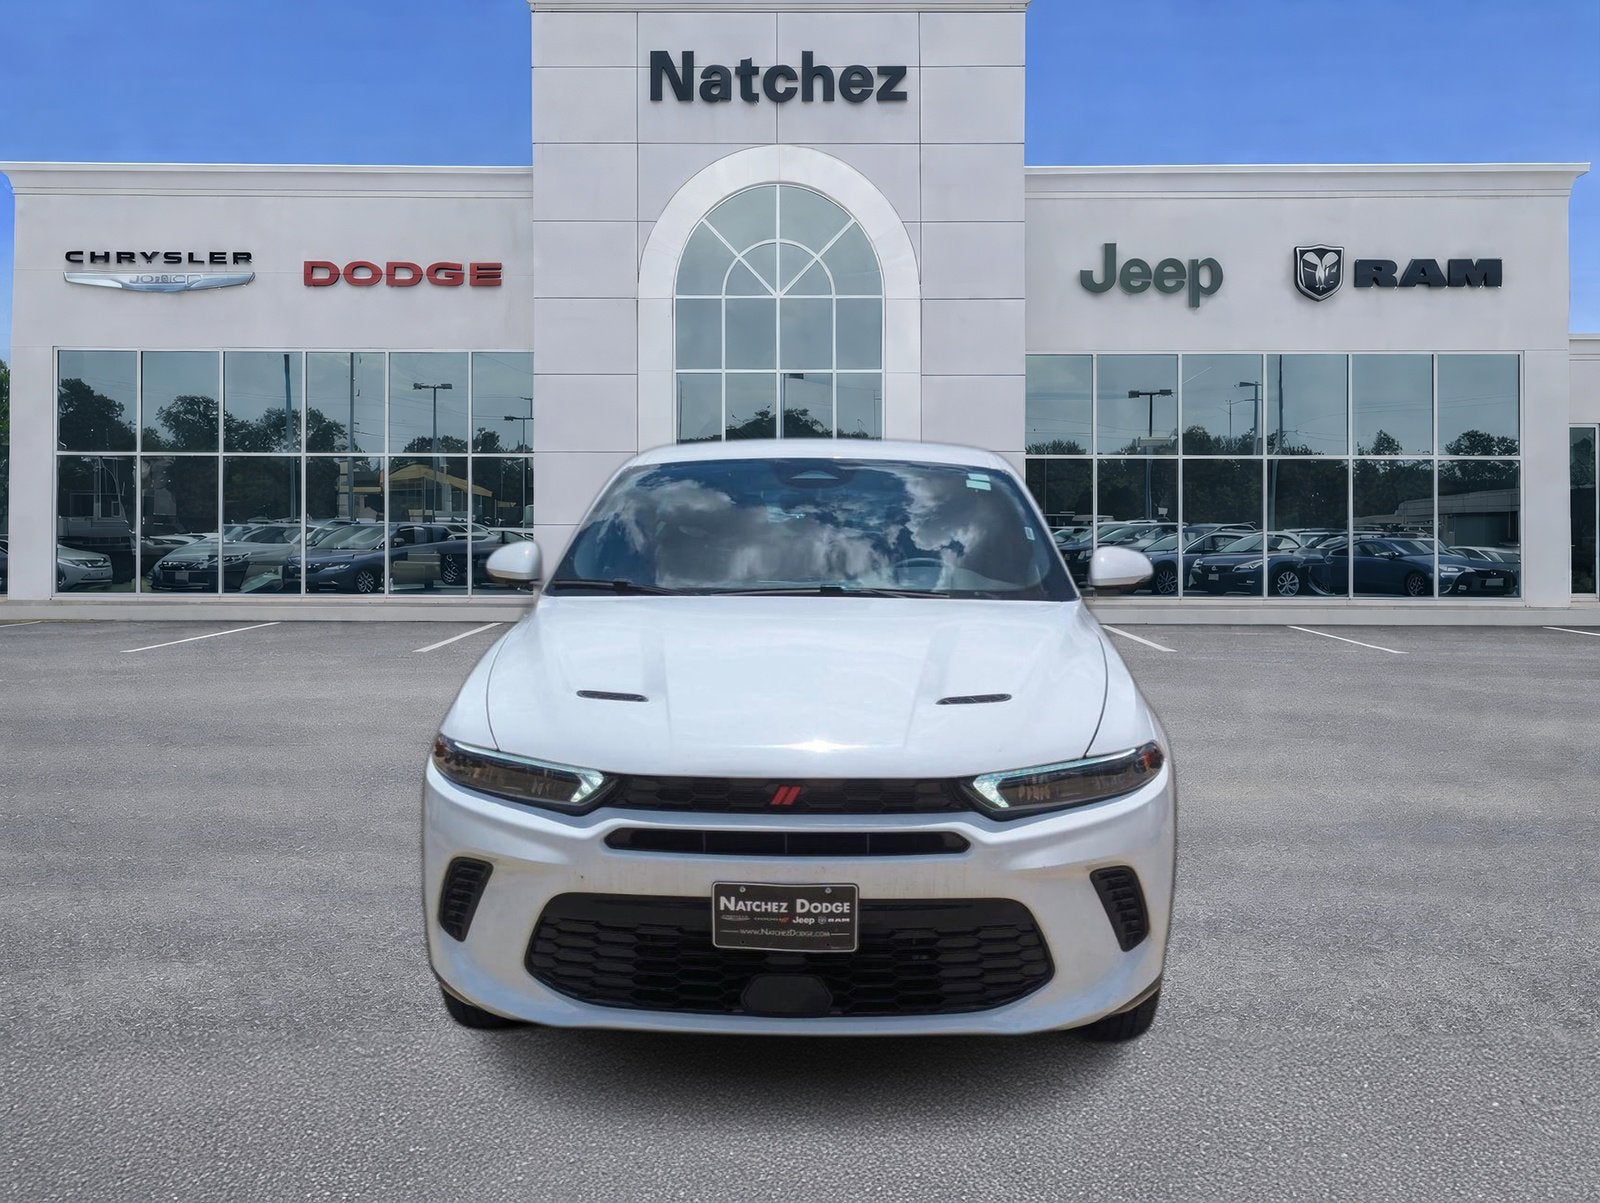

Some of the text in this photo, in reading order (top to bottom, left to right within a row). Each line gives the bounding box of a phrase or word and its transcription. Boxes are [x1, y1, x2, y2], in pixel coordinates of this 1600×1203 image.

[650, 50, 908, 104] Natchez
[64, 250, 253, 265] CHRYSLER
[303, 260, 503, 287] DODGE
[1080, 242, 1224, 309] Jeep
[1354, 257, 1504, 289] RAM
[795, 898, 851, 914] DODGE
[792, 916, 816, 926] Jeep
